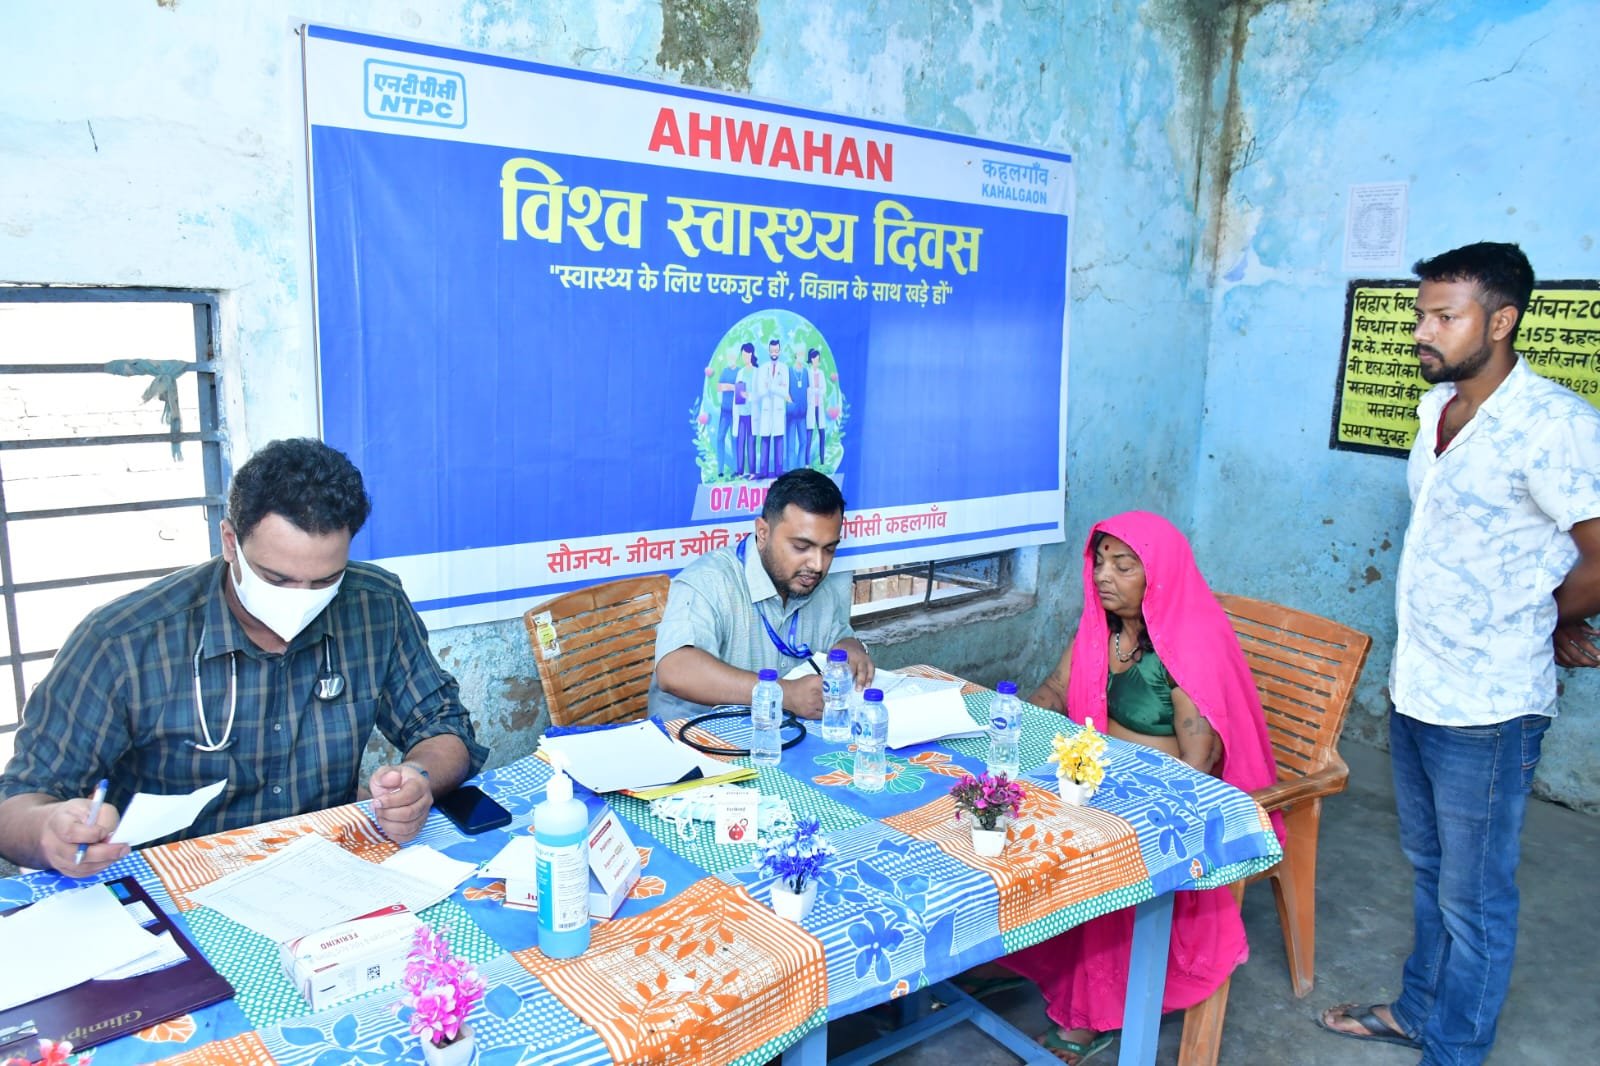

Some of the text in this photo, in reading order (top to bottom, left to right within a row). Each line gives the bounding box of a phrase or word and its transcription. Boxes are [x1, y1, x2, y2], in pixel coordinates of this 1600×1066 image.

[374, 73, 457, 101] एनटीपीसी
[380, 94, 453, 119] NTPC
[648, 107, 893, 182] AHWAHAN
[982, 158, 1049, 187] कहलगाँव
[981, 183, 1048, 206] KAHALGAON
[500, 157, 983, 275] विश्व स्वास्थ्य दिवस
[637, 262, 659, 291] के
[663, 264, 703, 293] लिए
[707, 273, 764, 304] एकजुट
[800, 272, 849, 300] विज्ञान
[852, 275, 868, 300] के
[872, 282, 902, 302] साथ
[905, 279, 930, 308] खड़े
[1355, 315, 1398, 335] विधान
[1341, 422, 1374, 438] समय
[710, 487, 732, 511] 07
[546, 543, 620, 573] सौजन्य-
[626, 536, 675, 563] जीवन
[679, 528, 729, 556] ज्योति
[885, 504, 947, 533] कहलगाँव
